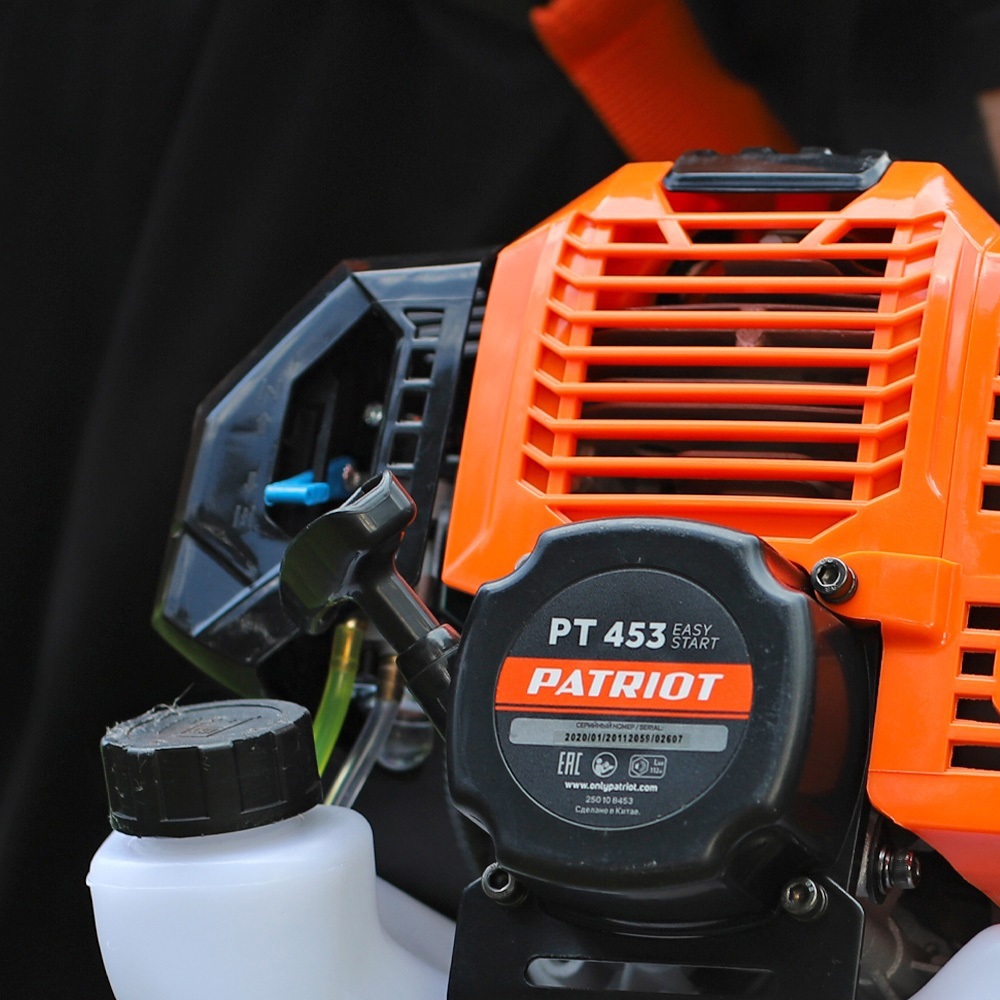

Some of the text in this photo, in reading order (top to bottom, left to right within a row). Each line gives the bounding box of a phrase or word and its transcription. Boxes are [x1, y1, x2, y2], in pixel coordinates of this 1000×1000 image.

[549, 617, 667, 649] PT 453
[672, 623, 713, 637] EASY
[670, 636, 720, 650] START
[526, 667, 724, 701] PATRIOT
[564, 781, 659, 793] www.onlypatriot.com
